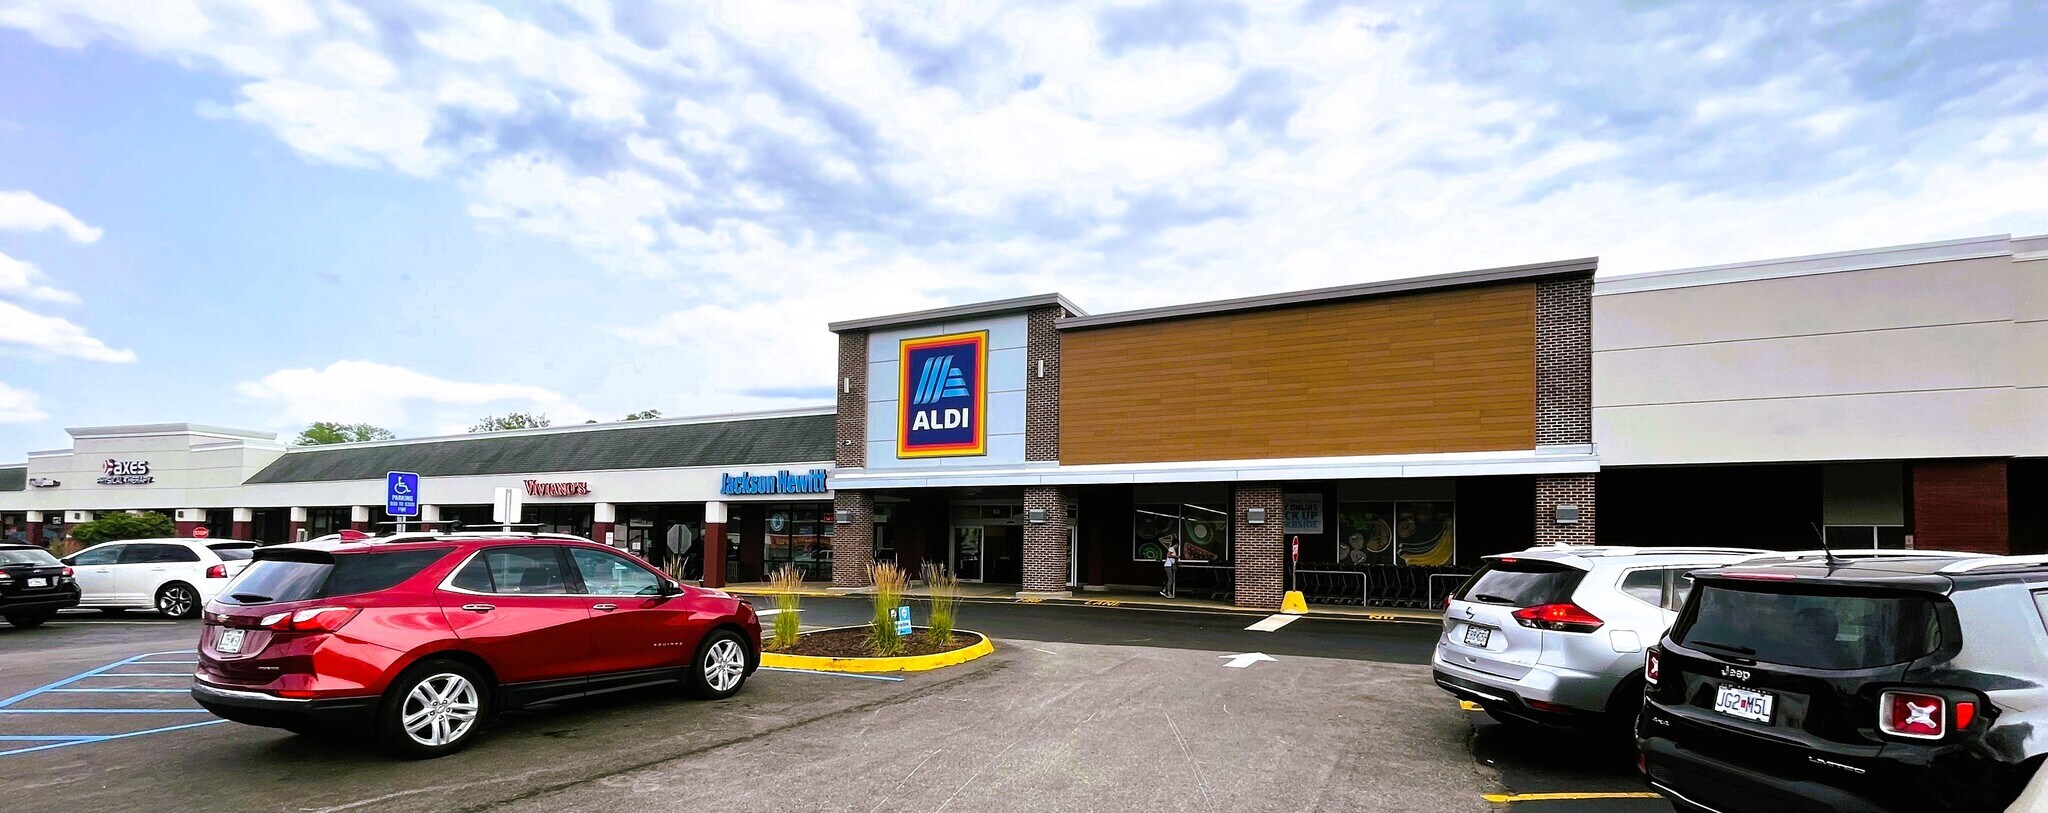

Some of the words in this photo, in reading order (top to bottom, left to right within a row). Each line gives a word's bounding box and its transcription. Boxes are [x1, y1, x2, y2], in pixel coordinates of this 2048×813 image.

[912, 408, 969, 431] ALDI
[720, 472, 777, 495] Jackson
[777, 469, 827, 493] Hewitt
[1285, 511, 1300, 520] CK
[1302, 511, 1318, 520] UP
[1286, 520, 1318, 529] RBSIDE
[1721, 665, 1751, 681] Jeep
